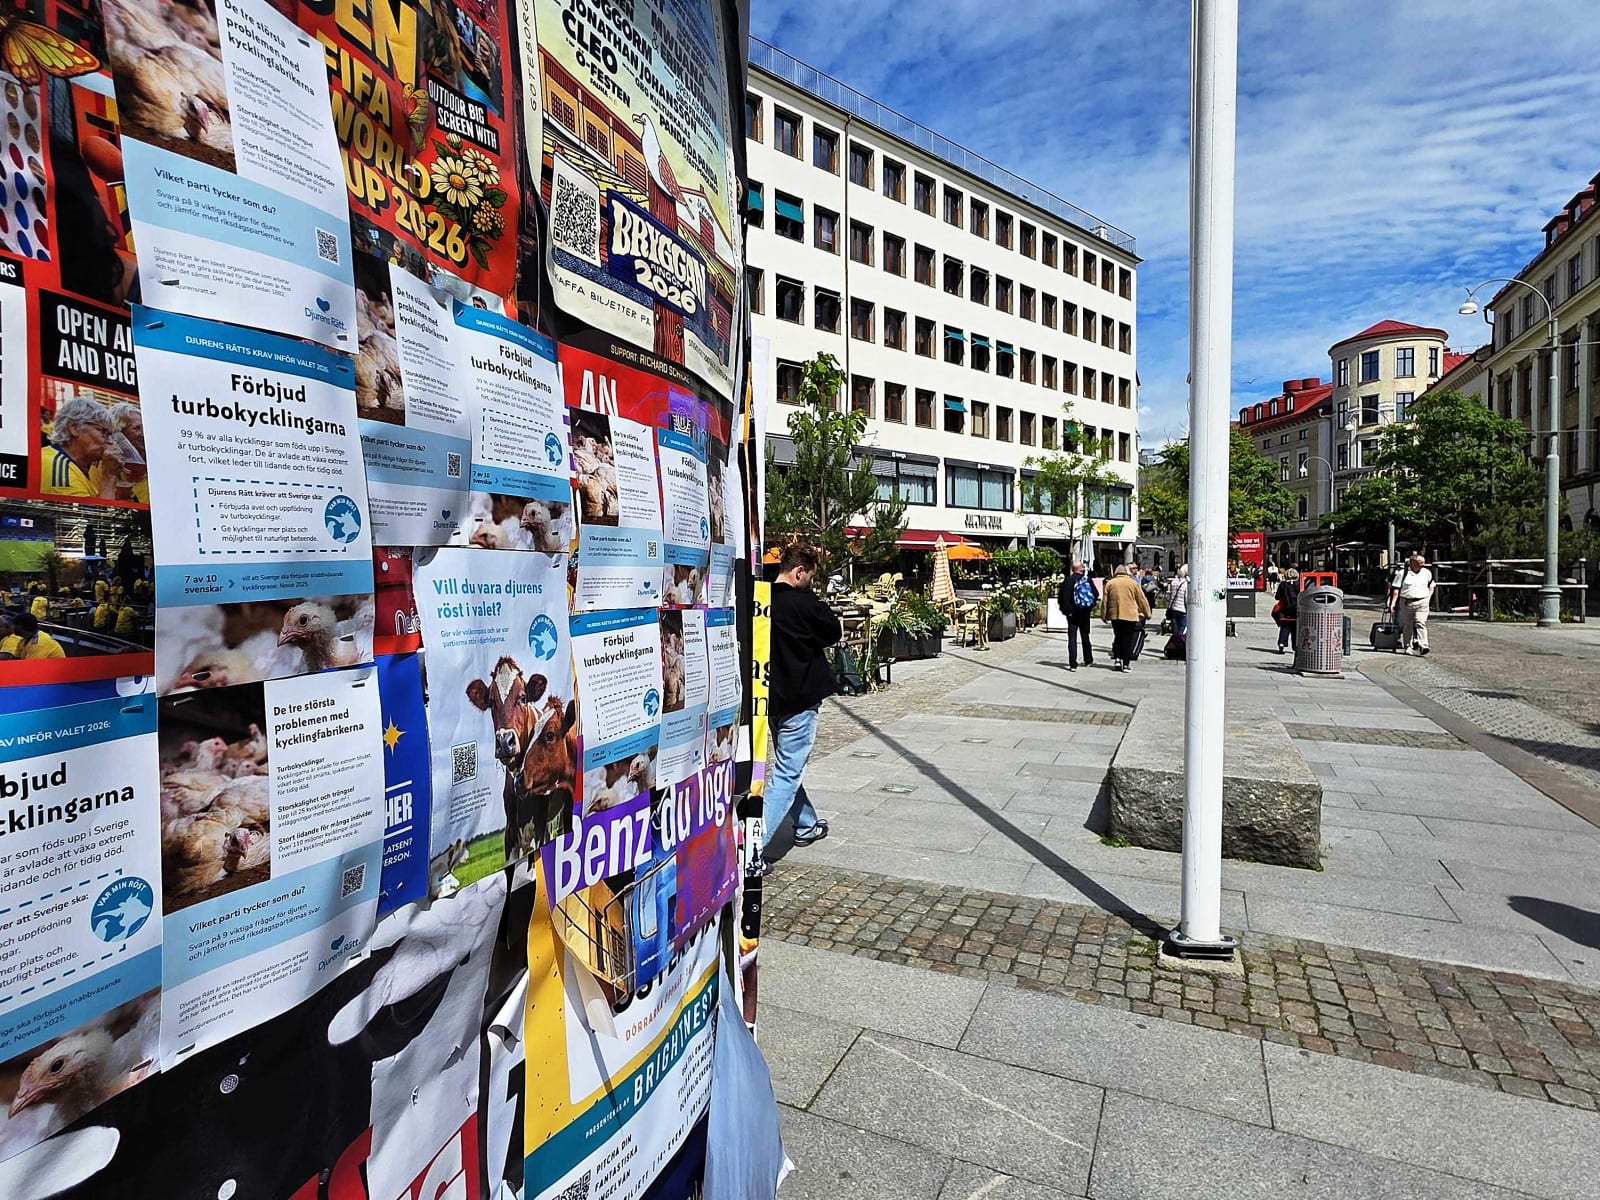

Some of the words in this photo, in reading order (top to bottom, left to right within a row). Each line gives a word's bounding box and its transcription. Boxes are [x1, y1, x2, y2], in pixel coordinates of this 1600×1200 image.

[224, 0, 239, 14] De
[240, 8, 255, 25] tre
[226, 17, 281, 58] problemen
[281, 53, 301, 73] med
[562, 9, 618, 75] CLEO
[227, 31, 315, 96] kycklingfabrikerna
[316, 29, 391, 128] FIFA
[569, 0, 639, 70] JONATHAN
[640, 58, 698, 134] JOHANSSON
[575, 48, 631, 108] Ö-FESTEN
[428, 78, 467, 117] OUTDOOR
[467, 102, 485, 125] BIG
[436, 104, 475, 140] SCREEN
[475, 122, 498, 150] WITH
[154, 167, 185, 185] Vilket
[187, 179, 211, 194] parti
[212, 186, 241, 203] tycker
[242, 197, 261, 210] som
[261, 203, 277, 216] du?
[156, 189, 181, 203] Svara
[342, 152, 387, 209] UP
[391, 187, 467, 262] 2026
[611, 199, 707, 311] BRYGGAN
[634, 259, 697, 314] 2026
[590, 291, 638, 319] BILJETTER
[56, 304, 107, 347] OPEN
[113, 321, 135, 353] AI
[58, 339, 100, 376] AND
[104, 352, 137, 386] BIG
[185, 335, 225, 350] DJURENS
[225, 343, 252, 355] RÄTTS
[252, 349, 273, 360] KRAV
[499, 344, 533, 369] Förbjud
[610, 344, 640, 363] SUPPORT:
[639, 354, 668, 374] RICHARD
[231, 373, 306, 403] Förbjud
[470, 355, 553, 394] turbokycklingarna
[171, 394, 347, 436] turbokycklingarna
[177, 442, 186, 450] är
[255, 448, 266, 457] De
[180, 429, 193, 439] 99
[194, 431, 205, 440] %
[218, 433, 233, 443] alla
[234, 435, 273, 448] kycklingar
[274, 441, 291, 449] som
[208, 457, 231, 466] vilket
[231, 458, 252, 467] leder
[264, 461, 291, 471] lidande
[208, 487, 237, 498] Djurens
[238, 488, 254, 497] Rätt
[218, 501, 250, 512] Förbjuda
[220, 525, 232, 533] Ge
[184, 583, 224, 595] svenskar
[185, 575, 191, 584] 7
[193, 576, 204, 584] av
[206, 574, 218, 583] 10
[432, 578, 458, 595] Vill
[460, 578, 476, 594] du
[477, 582, 502, 594] vara
[504, 579, 543, 598] djurens
[437, 602, 464, 619] röst
[472, 601, 503, 617] valet?
[603, 632, 635, 648] Förbjud
[583, 645, 654, 668] turbokycklingarna
[273, 705, 287, 717] De
[288, 702, 302, 714] tre
[304, 697, 336, 712] största
[274, 715, 328, 736] problemen
[329, 708, 350, 722] med
[17, 731, 53, 745] INFÖR
[54, 725, 86, 739] VALET
[87, 720, 112, 732] 2026:
[275, 722, 365, 749] kycklingfabrikerna
[277, 756, 326, 774] Turbokycklingar
[277, 795, 320, 813] Storskalighet
[15, 846, 39, 860] som
[42, 838, 65, 852] föds
[67, 832, 87, 846] upp
[94, 818, 130, 836] Sverige
[278, 834, 296, 846] Stort
[296, 827, 320, 840] lidande
[320, 823, 330, 834] för
[330, 818, 350, 831] många
[350, 809, 374, 823] individer
[3, 868, 15, 878] är
[18, 856, 55, 873] avlade
[57, 849, 72, 861] att
[73, 842, 96, 855] växa
[98, 829, 135, 847] extremt
[555, 806, 652, 903] Benz
[661, 783, 691, 851] du
[42, 867, 62, 880] och
[63, 860, 79, 872] för
[80, 852, 103, 868] tidig
[103, 845, 125, 859] död.
[383, 851, 412, 867] ERSON.
[97, 888, 113, 907] VAR
[111, 881, 127, 895] MIN
[128, 879, 147, 892] RÖST
[16, 914, 31, 926] att
[33, 900, 70, 920] Sverige
[71, 893, 89, 906] ska:
[189, 918, 217, 933] Vilket
[219, 908, 241, 924] parti
[242, 899, 271, 915] tycker
[271, 893, 290, 906] som
[291, 885, 306, 899] du?
[18, 916, 72, 943] uppfödning
[188, 938, 211, 952] Svara
[211, 933, 222, 944] på
[222, 930, 229, 939] 9
[229, 922, 254, 937] viktiga
[254, 915, 276, 930] frågor
[276, 911, 288, 921] för
[287, 903, 308, 917] djuren
[188, 950, 203, 962] och
[202, 941, 228, 957] jämför
[229, 934, 246, 946] med
[246, 911, 308, 939] riksdagspartiernas
[19, 954, 44, 972] plats
[46, 945, 64, 959] och
[34, 951, 80, 975] beteende.
[318, 950, 344, 971] Djurens
[16, 1018, 32, 1030] ska
[32, 1002, 67, 1024] förbjuda
[68, 977, 122, 1007] snabbväxande
[14, 1025, 41, 1042] Novus
[625, 1001, 664, 1042] DÖRRARNA
[633, 984, 713, 1108] BRIGHTNEST
[594, 1144, 638, 1193] FANTASTISKA
[596, 1146, 620, 1175] PITCHA
[621, 1133, 633, 1151] DIN
